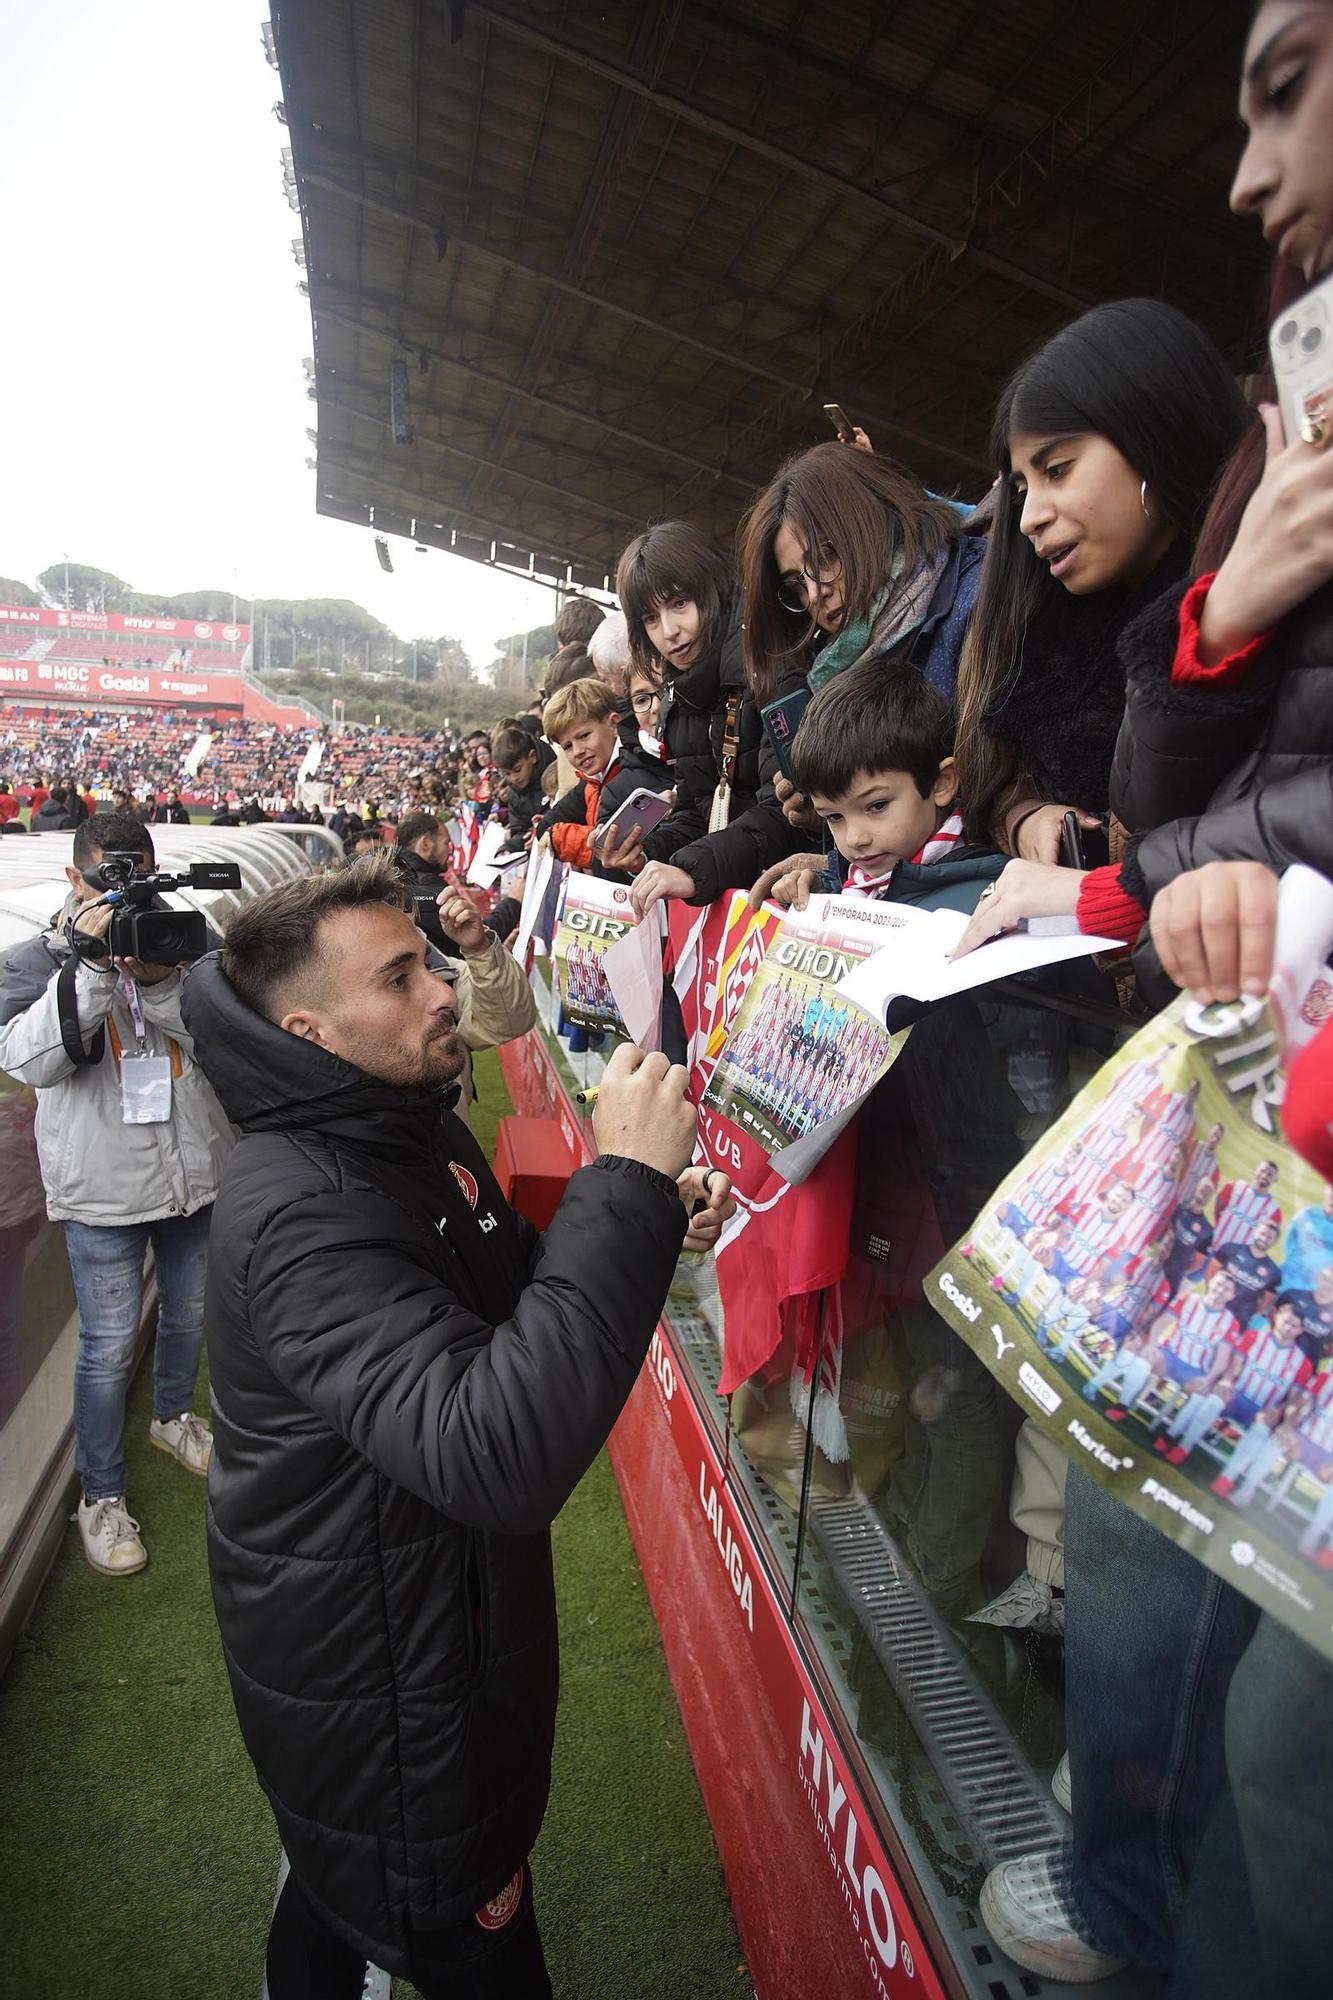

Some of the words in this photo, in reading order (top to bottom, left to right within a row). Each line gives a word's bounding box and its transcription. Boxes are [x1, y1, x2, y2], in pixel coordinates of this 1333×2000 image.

[54, 665, 89, 682] MGC
[99, 673, 150, 693] Gosbi
[566, 909, 637, 940] GIR
[831, 905, 872, 924] TEMPORADA
[939, 1272, 982, 1322] Gosbi
[700, 1461, 754, 1633] LALIGA
